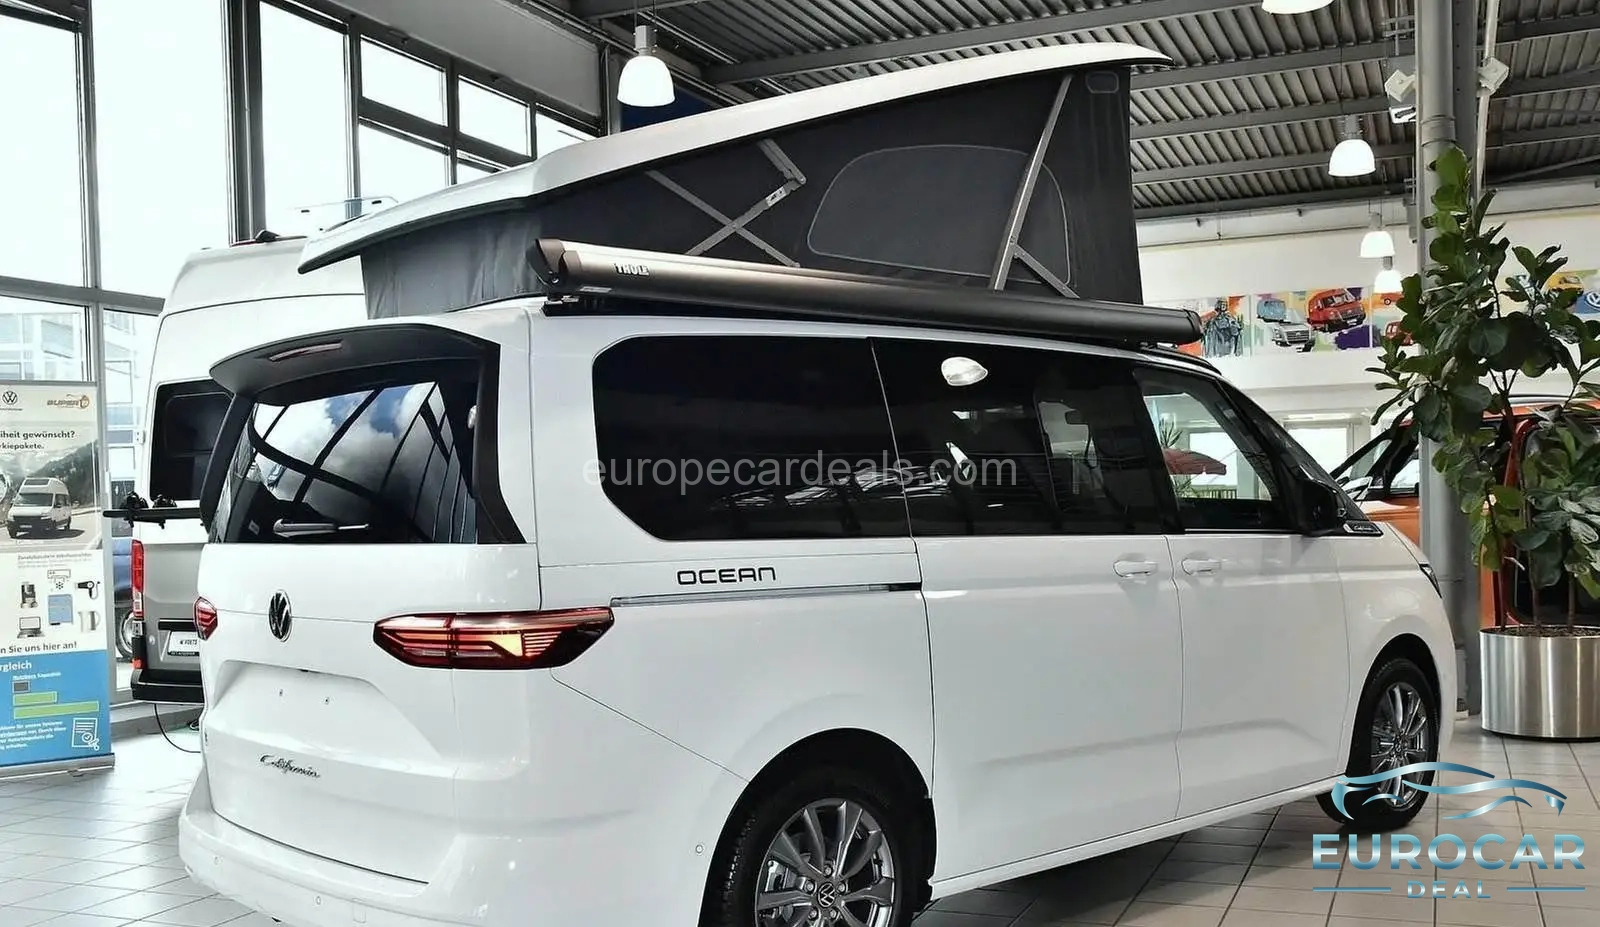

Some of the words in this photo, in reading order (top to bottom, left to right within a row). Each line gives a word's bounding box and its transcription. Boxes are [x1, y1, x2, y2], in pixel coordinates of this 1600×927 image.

[613, 263, 650, 276] THULE
[22, 430, 75, 440] gewünscht?
[677, 567, 777, 585] OCEAN
[8, 645, 22, 654] Sie
[43, 643, 60, 651] hier
[62, 641, 77, 649] an!
[260, 754, 321, 778] California
